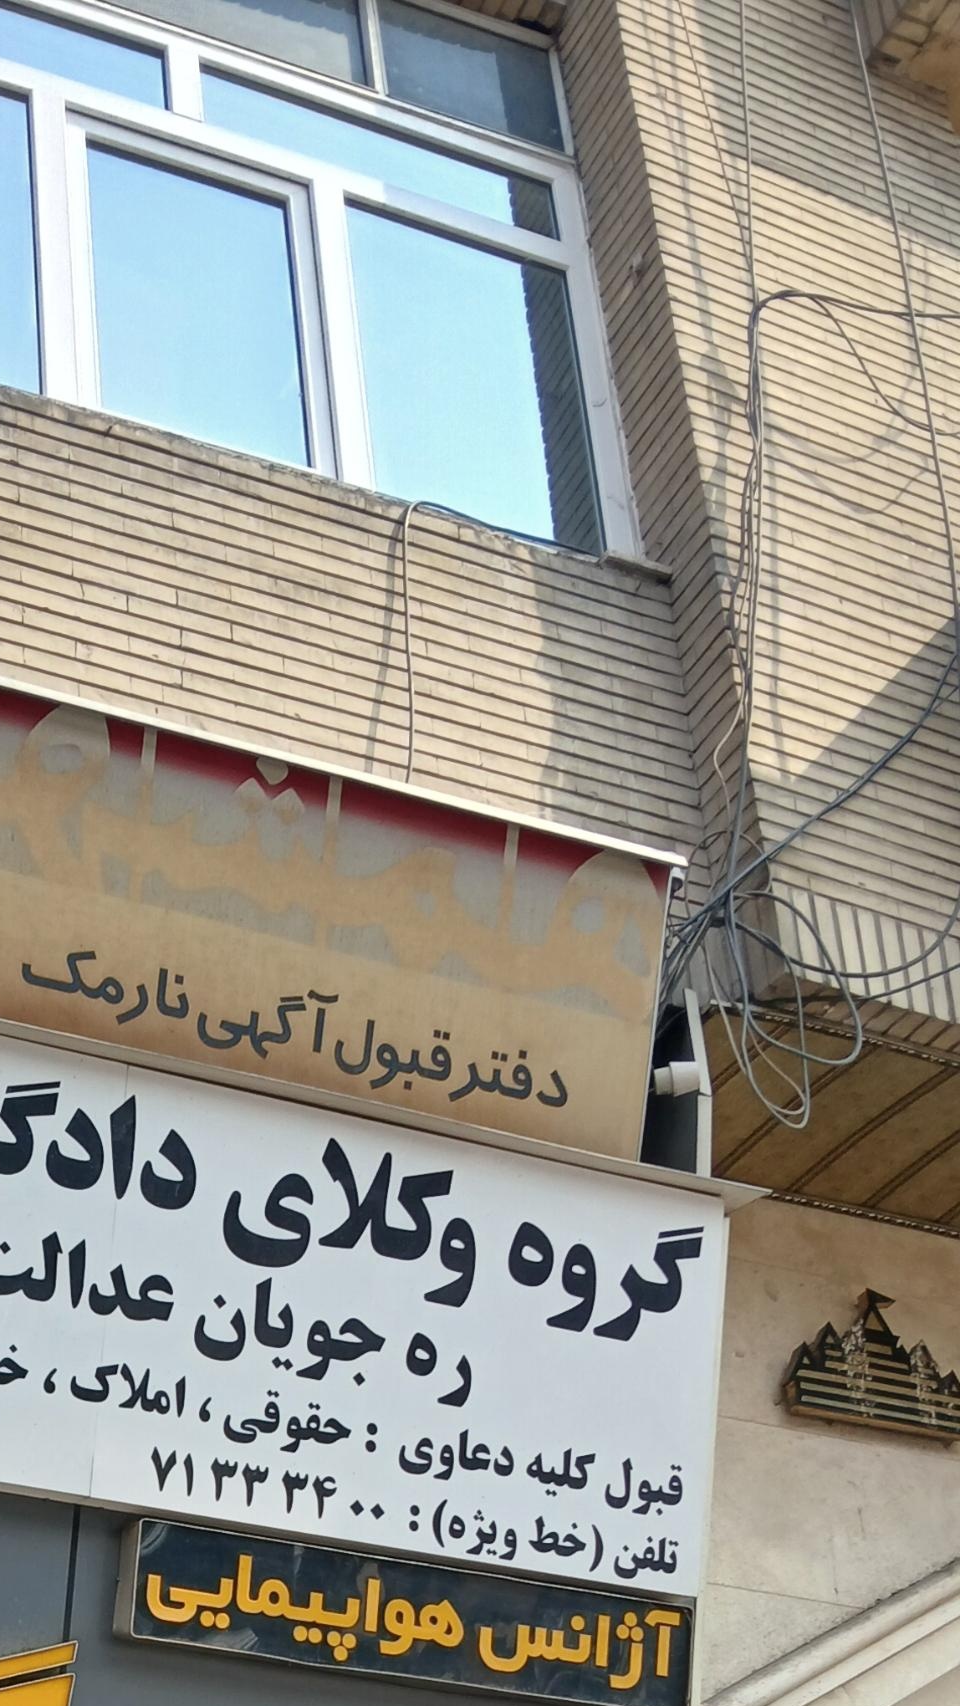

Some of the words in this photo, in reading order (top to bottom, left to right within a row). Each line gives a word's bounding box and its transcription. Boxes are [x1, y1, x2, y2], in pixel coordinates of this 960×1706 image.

[22, 951, 189, 1025] نارمک
[198, 990, 337, 1059] آگهی
[334, 1019, 451, 1091] قبول
[450, 1050, 568, 1108] دفتر
[223, 1138, 477, 1307] وکلای
[509, 1220, 705, 1342] گروه
[194, 1277, 386, 1385] جویان
[406, 1332, 472, 1407] ره
[399, 1431, 514, 1482] دعاوی
[526, 1449, 596, 1498] کلیه
[604, 1463, 683, 1516] قبول
[613, 1539, 678, 1578] تلفن
[146, 1554, 465, 1661] هواپیمایی
[478, 1608, 681, 1690] آژانس
